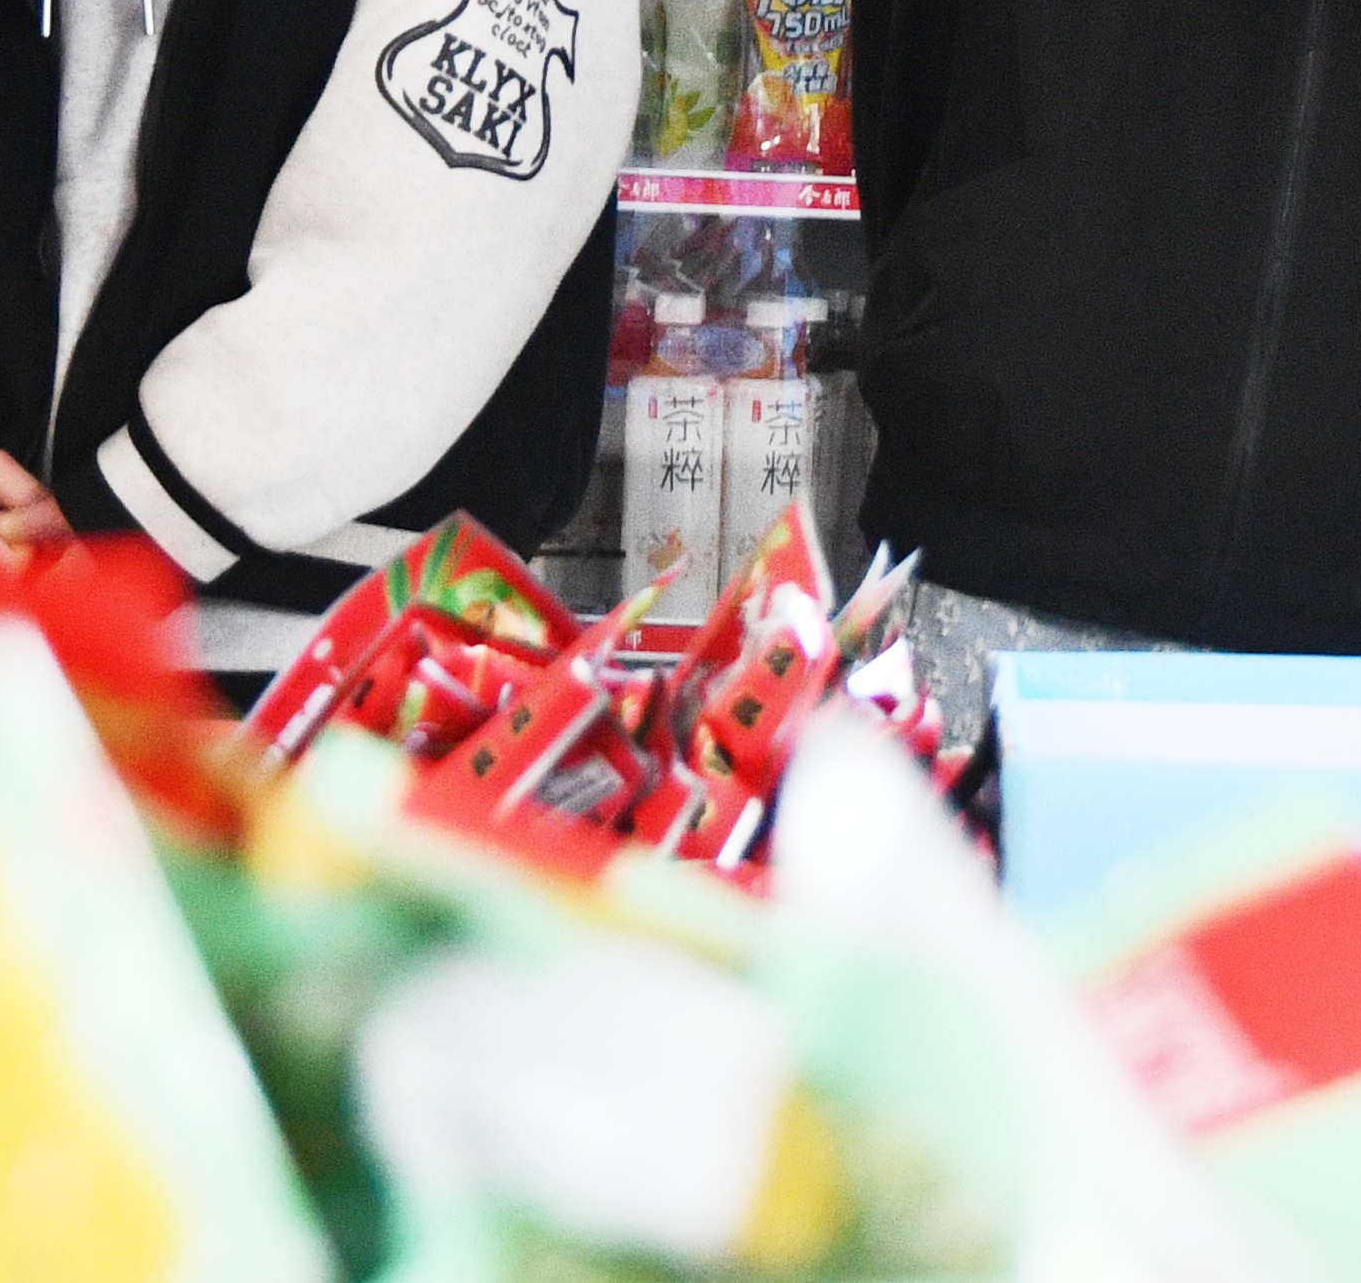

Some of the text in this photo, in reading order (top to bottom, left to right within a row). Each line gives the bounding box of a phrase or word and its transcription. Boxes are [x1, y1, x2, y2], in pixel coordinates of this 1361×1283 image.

[419, 74, 523, 158] SAKI
[431, 32, 536, 124] KLYX
[661, 395, 705, 493] 茶粹
[761, 400, 803, 495] 茶粹
